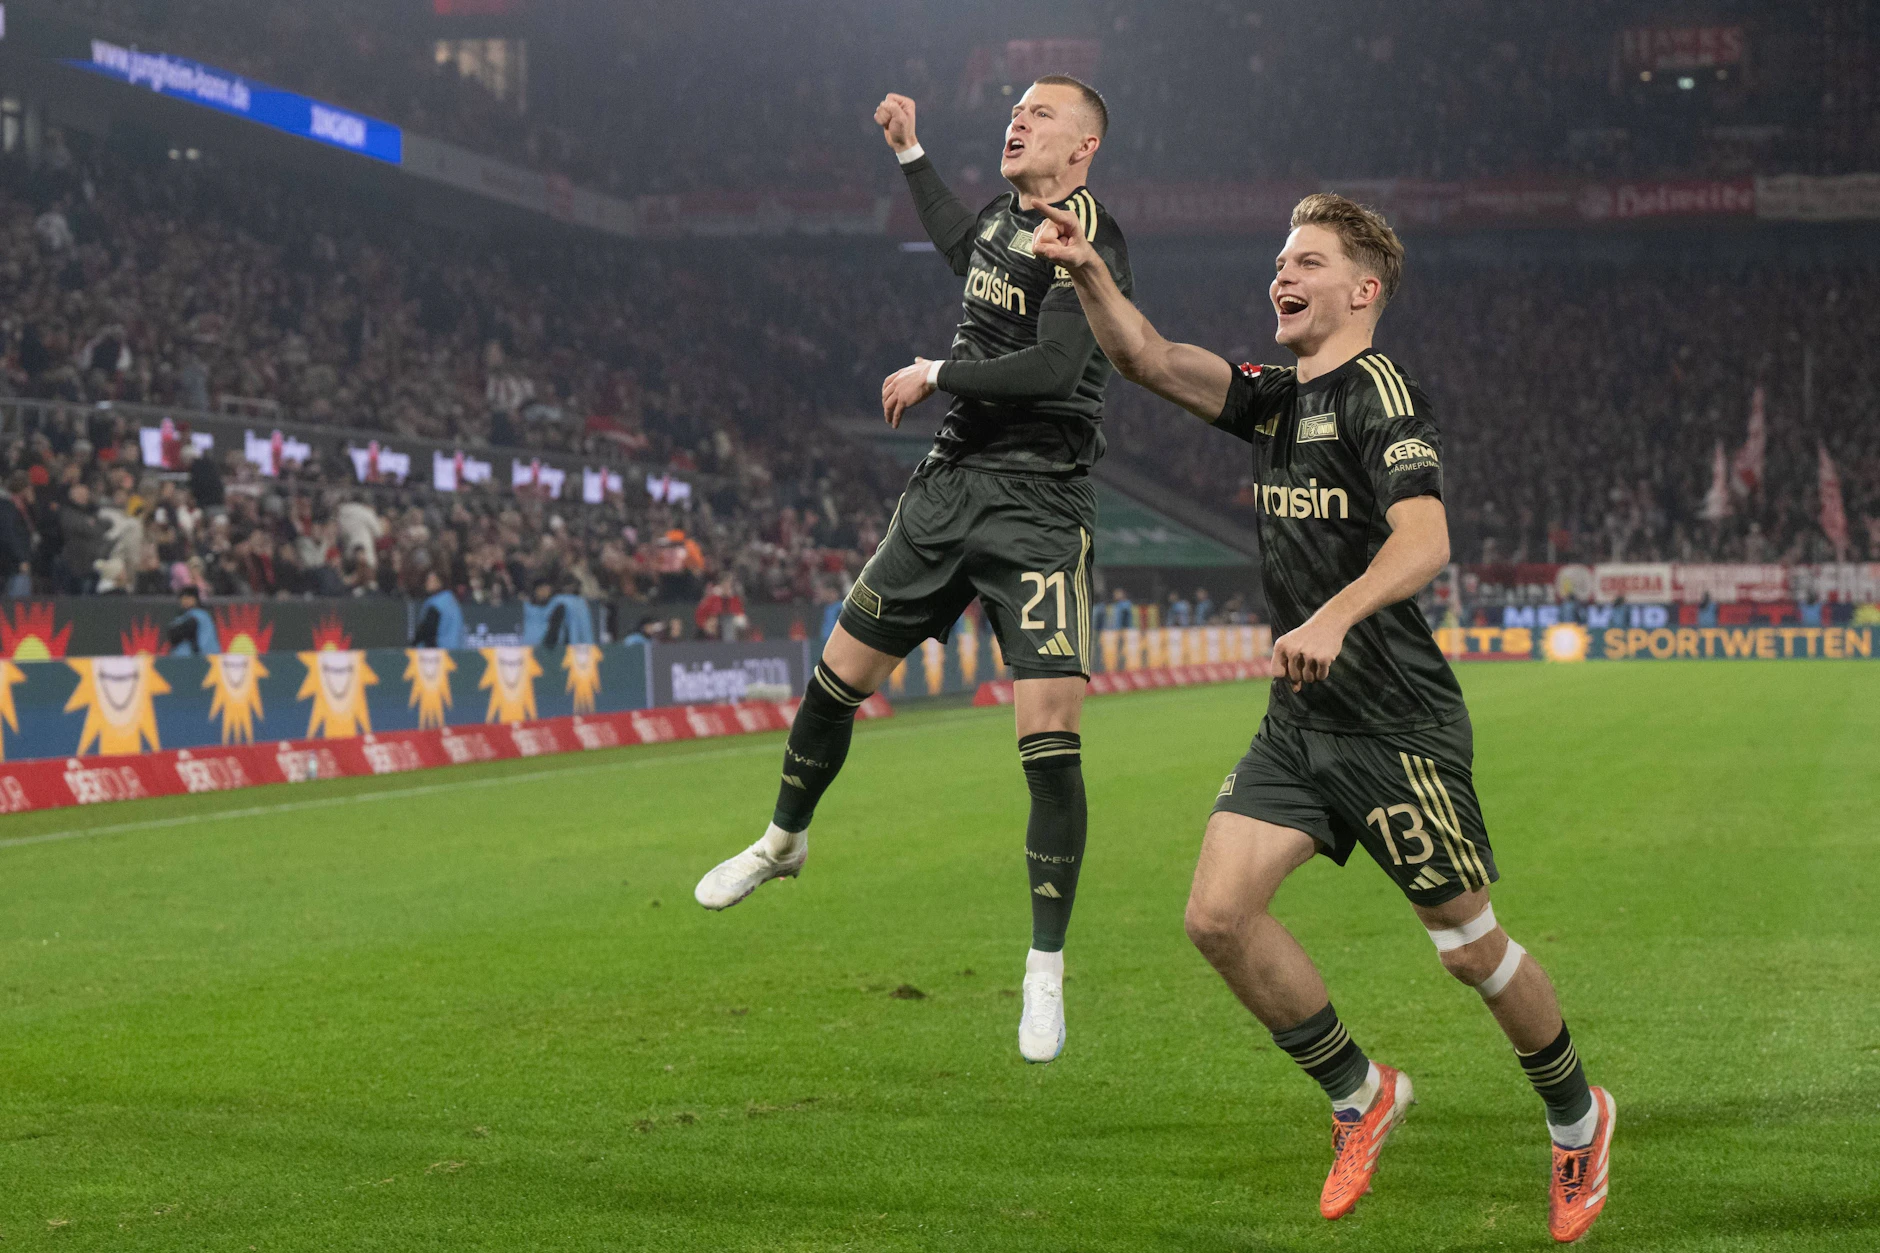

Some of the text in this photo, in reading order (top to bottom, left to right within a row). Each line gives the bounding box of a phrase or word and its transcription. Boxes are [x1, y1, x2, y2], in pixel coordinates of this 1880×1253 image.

[964, 266, 1027, 315] raisin
[1383, 438, 1439, 468] KERMI
[1020, 571, 1066, 629] 21
[1433, 628, 1532, 653] ETS
[1604, 627, 1872, 659] SPORTWETTEN
[1366, 802, 1434, 866] 13
